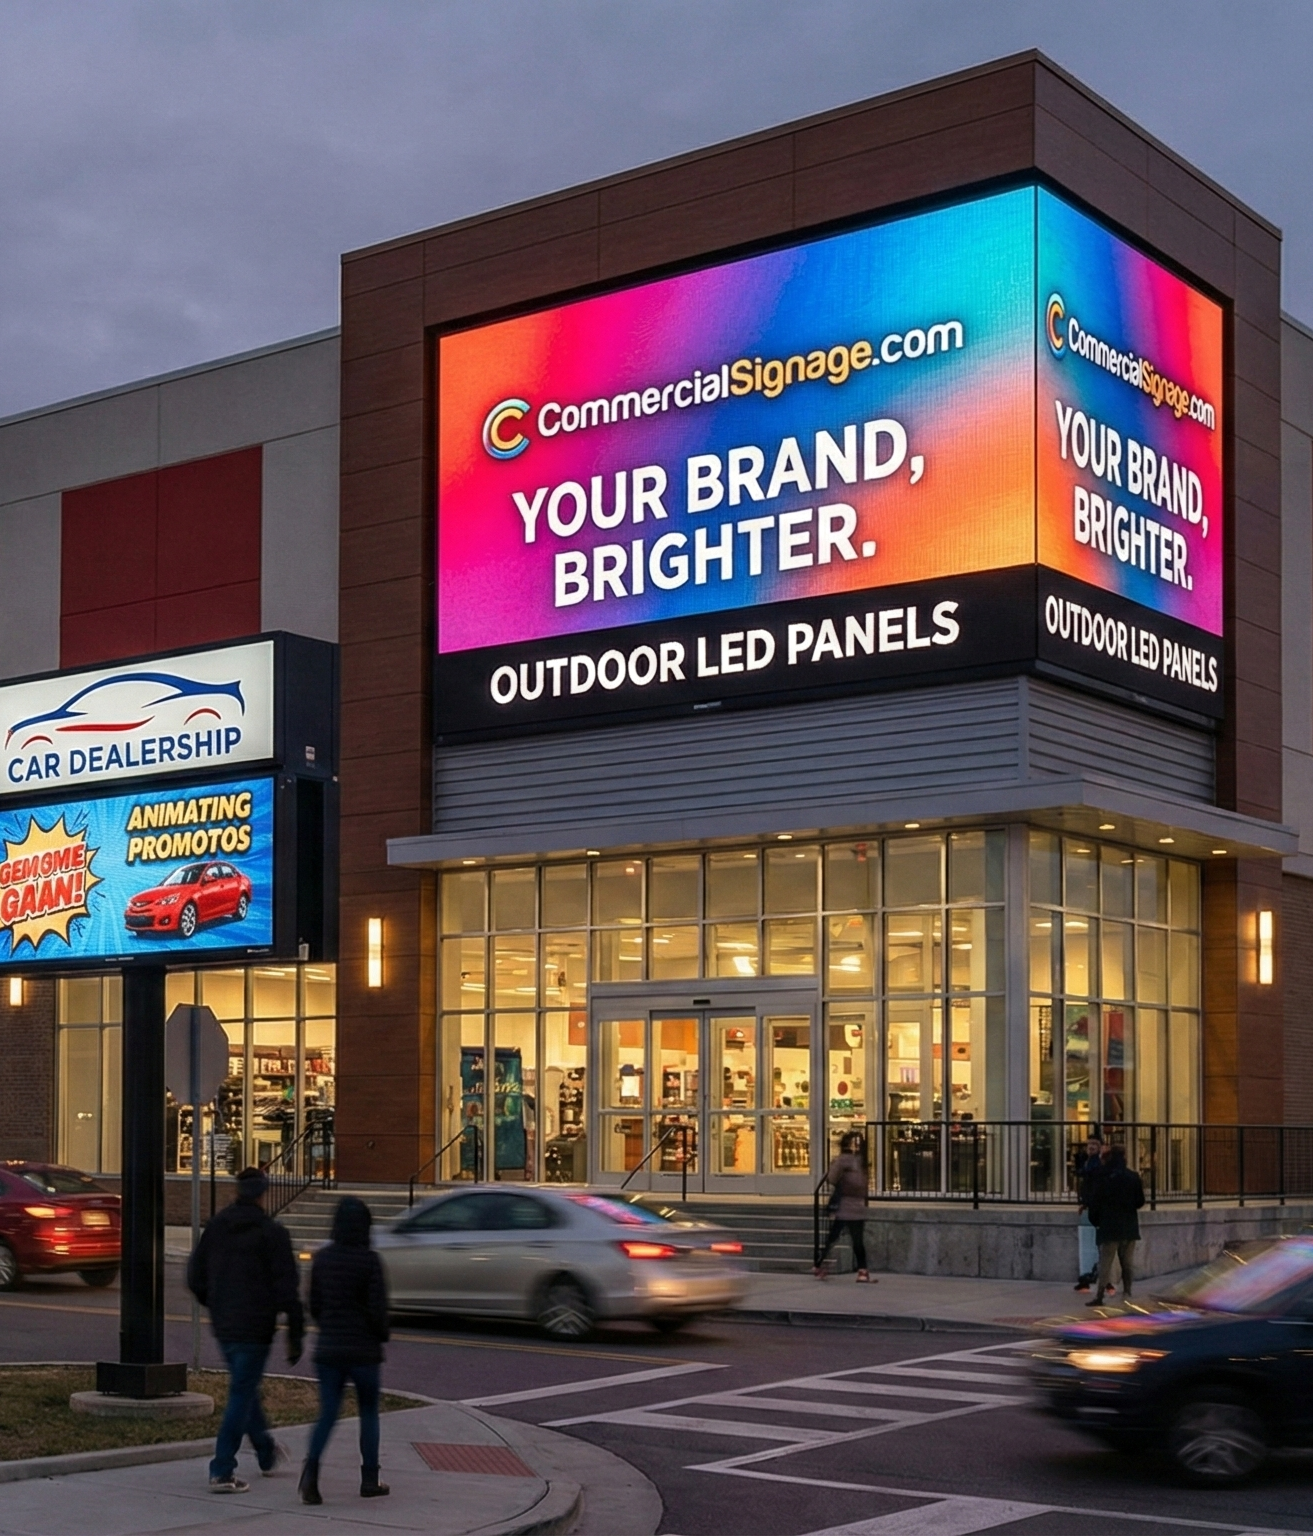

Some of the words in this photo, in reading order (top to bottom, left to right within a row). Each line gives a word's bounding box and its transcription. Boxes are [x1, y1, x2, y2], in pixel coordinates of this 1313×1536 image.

[537, 320, 964, 437] CommercialSignage.com
[1067, 317, 1216, 431] CommercialSignage.com
[512, 464, 669, 544] YOUR
[686, 418, 926, 514] BRAND,
[1055, 400, 1123, 487] YOUR
[1127, 438, 1209, 539] BRAND,
[554, 502, 877, 608] BRIGHTER.
[1074, 485, 1193, 591] BRIGHTER.
[489, 640, 686, 705] OUTDOOR
[696, 629, 776, 679] LED
[787, 600, 961, 665] PANELS
[1045, 595, 1128, 662] OUTDOOR
[1131, 627, 1160, 672] LED
[1163, 637, 1218, 693] PANELS
[7, 756, 61, 784] CAR
[69, 726, 242, 776] DEALERSHIP
[126, 792, 252, 831] ANIMATING
[126, 825, 252, 862] PROMOTOS
[0, 871, 84, 923] GAAN!
